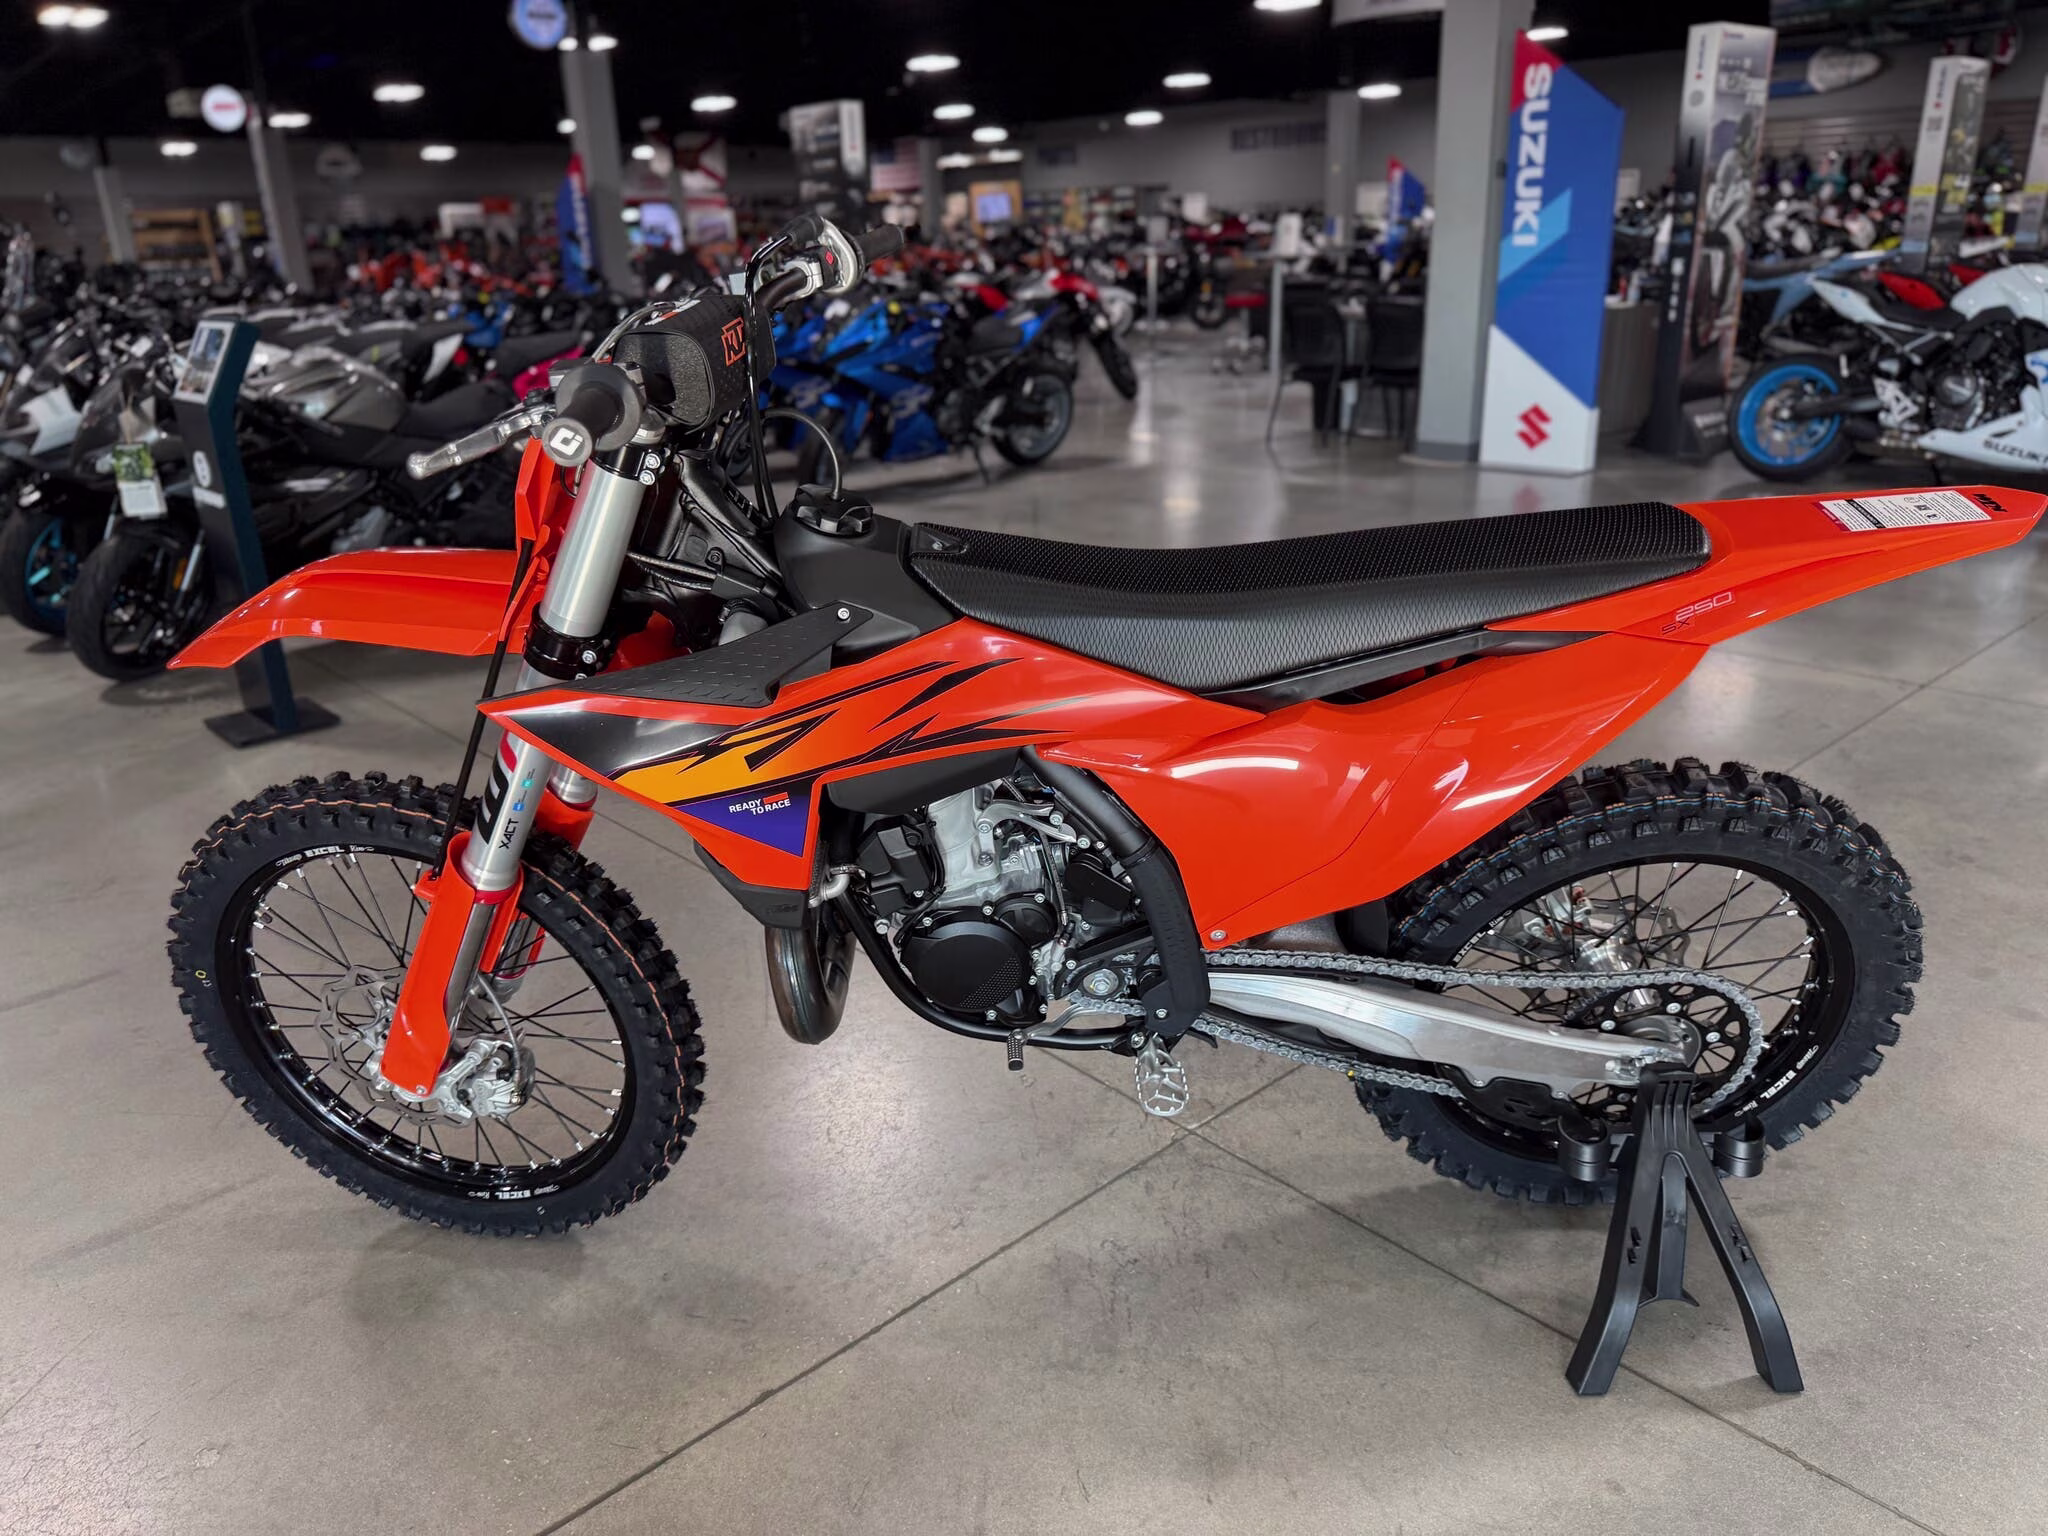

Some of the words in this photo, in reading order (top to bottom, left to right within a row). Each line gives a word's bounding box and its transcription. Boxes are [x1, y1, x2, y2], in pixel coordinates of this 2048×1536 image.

[1511, 62, 1553, 247] SUZUKI
[721, 316, 747, 367] KT
[1675, 591, 1733, 621] 250
[1661, 616, 1690, 636] SX
[728, 798, 762, 814] READY
[750, 806, 765, 816] TO
[764, 798, 792, 813] RACE
[499, 817, 520, 850] XACT
[303, 845, 346, 858] EXCEL
[1452, 931, 1487, 963] EXCEL
[1760, 1070, 1798, 1100] EXCEL
